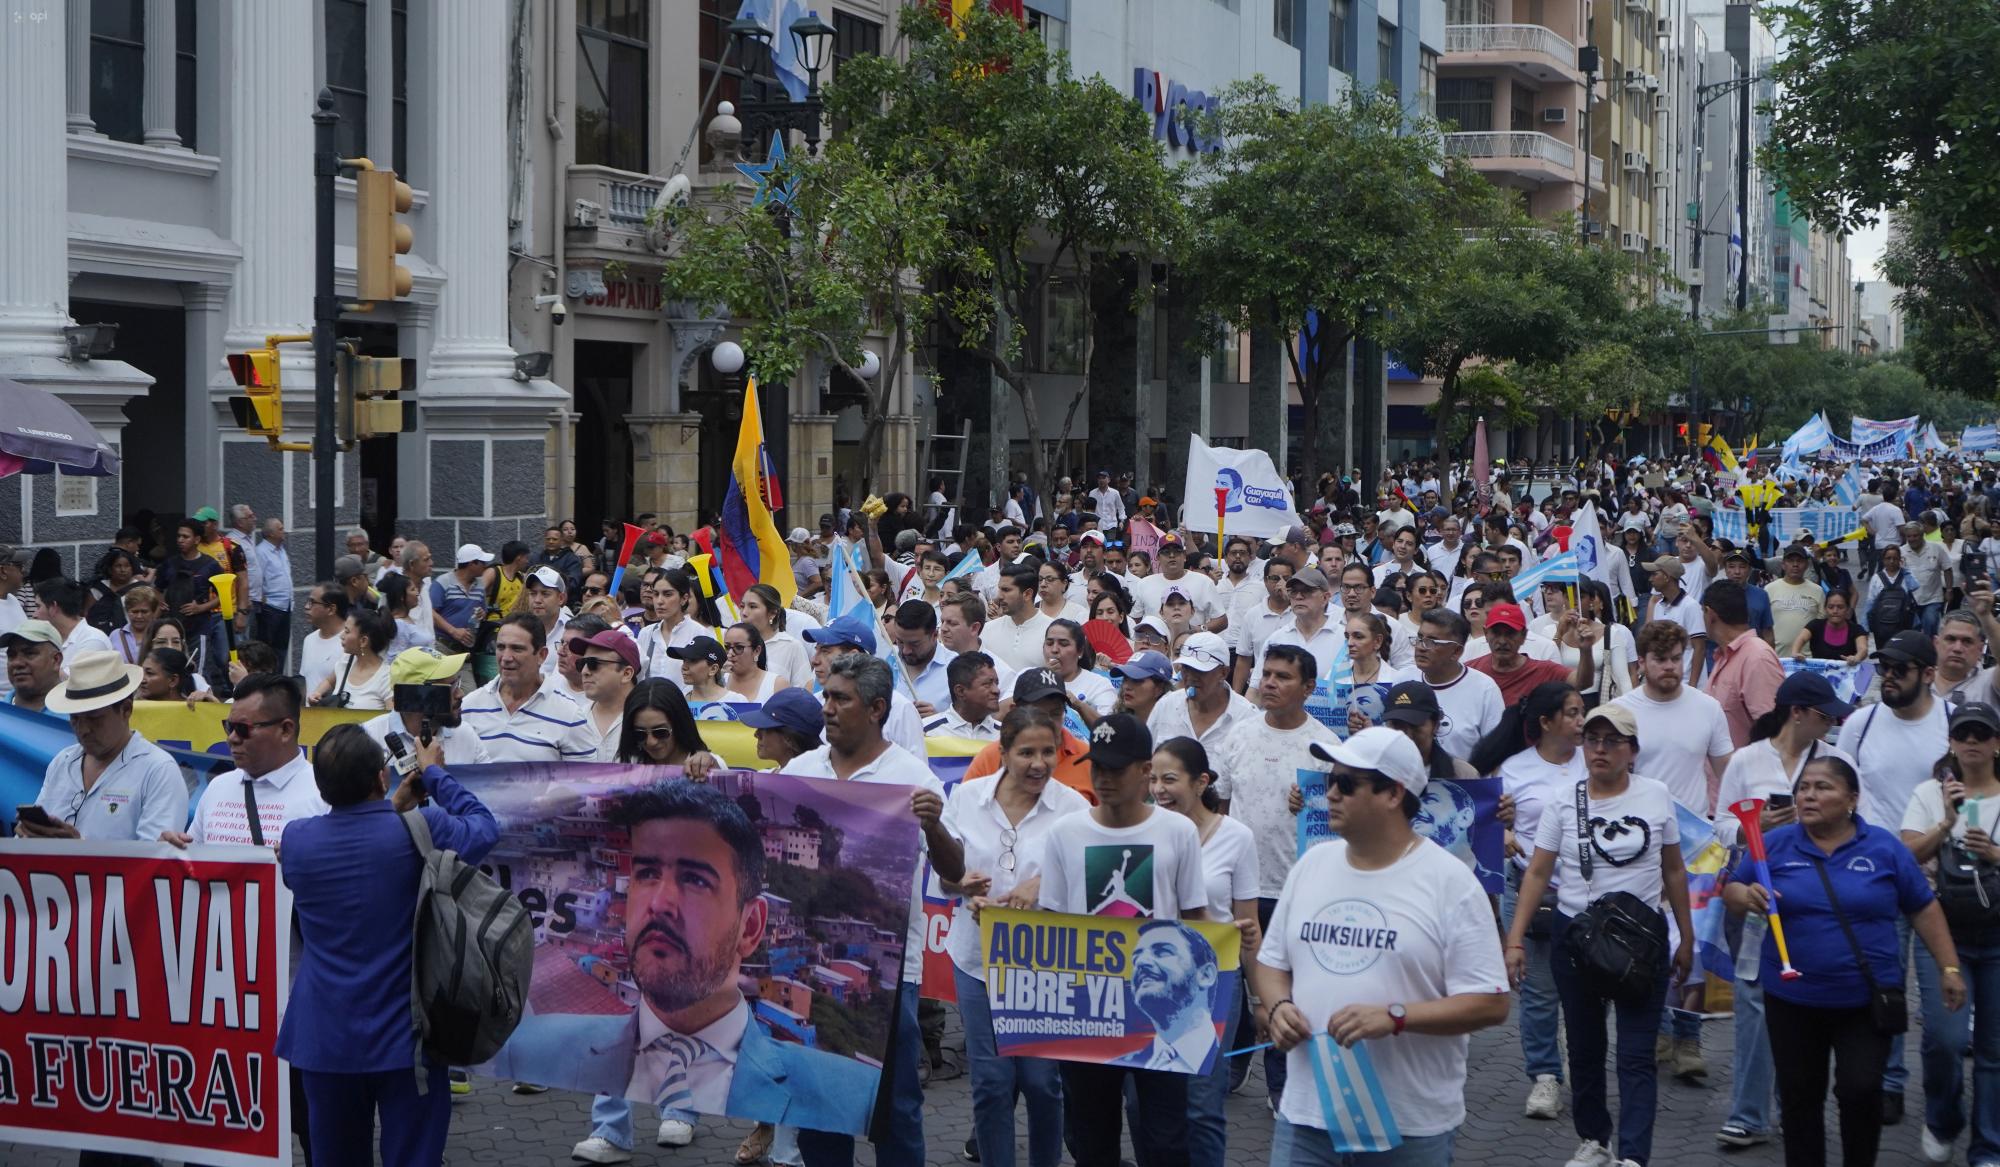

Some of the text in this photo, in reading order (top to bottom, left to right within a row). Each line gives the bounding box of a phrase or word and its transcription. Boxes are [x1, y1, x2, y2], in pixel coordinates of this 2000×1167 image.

[1245, 486, 1283, 500] Guayaquil
[1040, 669, 1058, 686] NY
[1578, 792, 1586, 809] LOVE
[215, 822, 245, 830] PUEBLO
[1579, 817, 1587, 834] LOVE
[989, 921, 1126, 974] AQUILES
[1300, 921, 1398, 951] QUIKSILVER
[153, 877, 260, 1031] VA!
[989, 966, 1126, 1020] LIBRE YA
[26, 1032, 264, 1132] FUERA!
